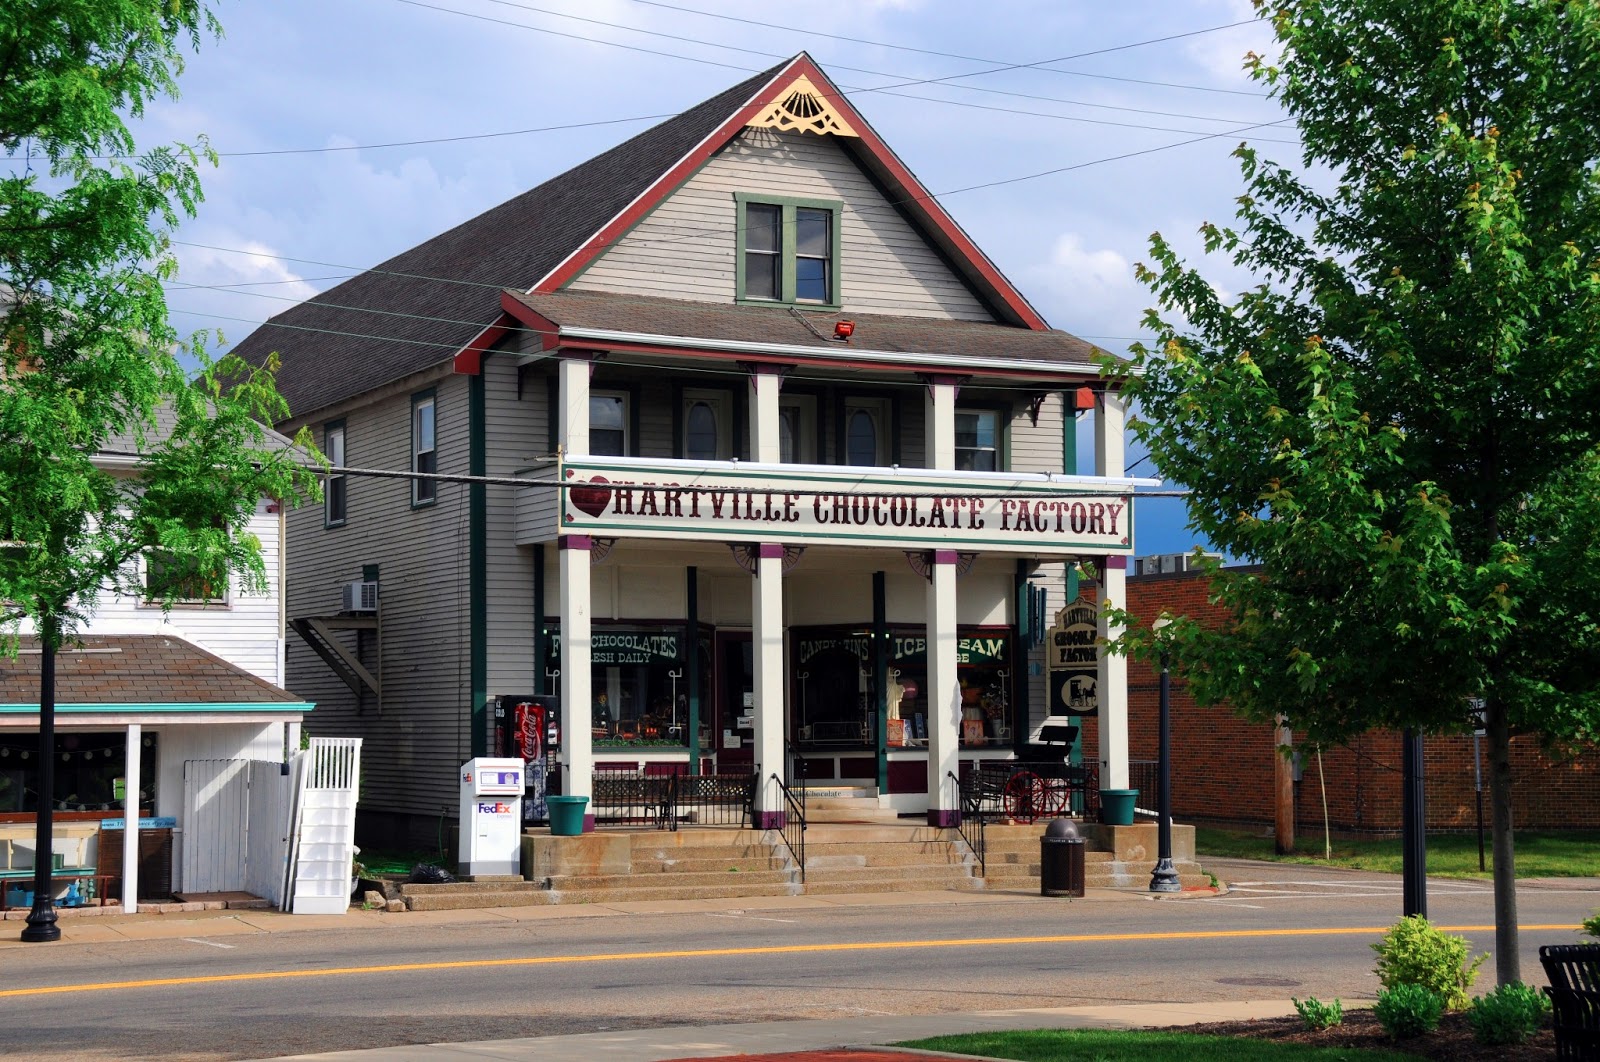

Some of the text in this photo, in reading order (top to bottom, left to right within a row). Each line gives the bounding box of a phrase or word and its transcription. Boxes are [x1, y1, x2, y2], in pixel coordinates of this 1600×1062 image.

[612, 481, 1125, 535] HARTVILLE CHOCOLATE FACTORY
[591, 635, 677, 658] CHOCOLATES
[800, 638, 869, 663] CANDY TINS
[895, 638, 926, 659] ICE
[959, 639, 1003, 660] EAM
[618, 653, 651, 663] DAILY
[478, 802, 511, 814] FedEx
